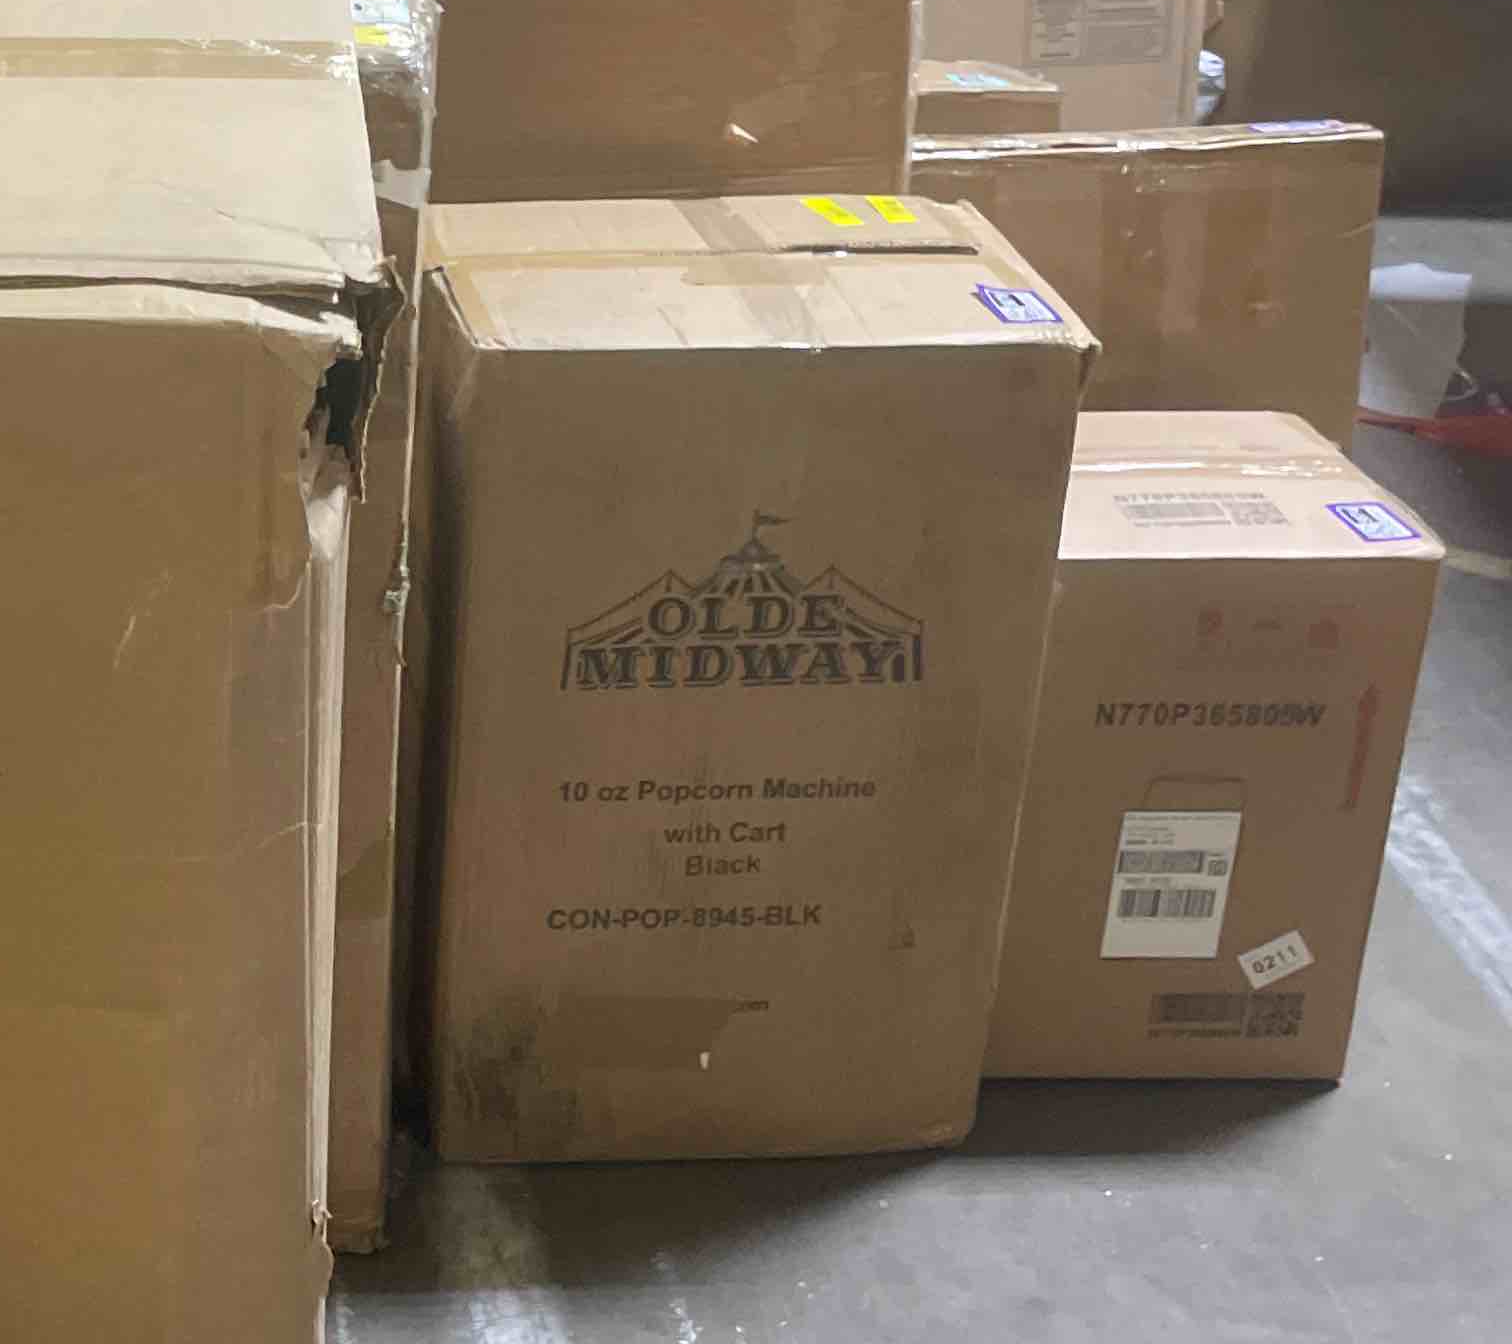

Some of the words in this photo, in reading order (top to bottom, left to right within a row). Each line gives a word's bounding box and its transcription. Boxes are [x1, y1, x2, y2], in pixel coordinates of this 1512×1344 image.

[647, 594, 844, 640] OLDE
[576, 640, 901, 690] MIDWAY
[559, 780, 589, 803] 10
[596, 782, 630, 802] oz
[637, 778, 754, 806] Popcorn
[761, 776, 878, 801] Machine
[663, 823, 721, 845] with
[728, 821, 788, 844] Cart
[684, 854, 762, 878] Black
[546, 904, 823, 932] CON-POP-8945-BLK
